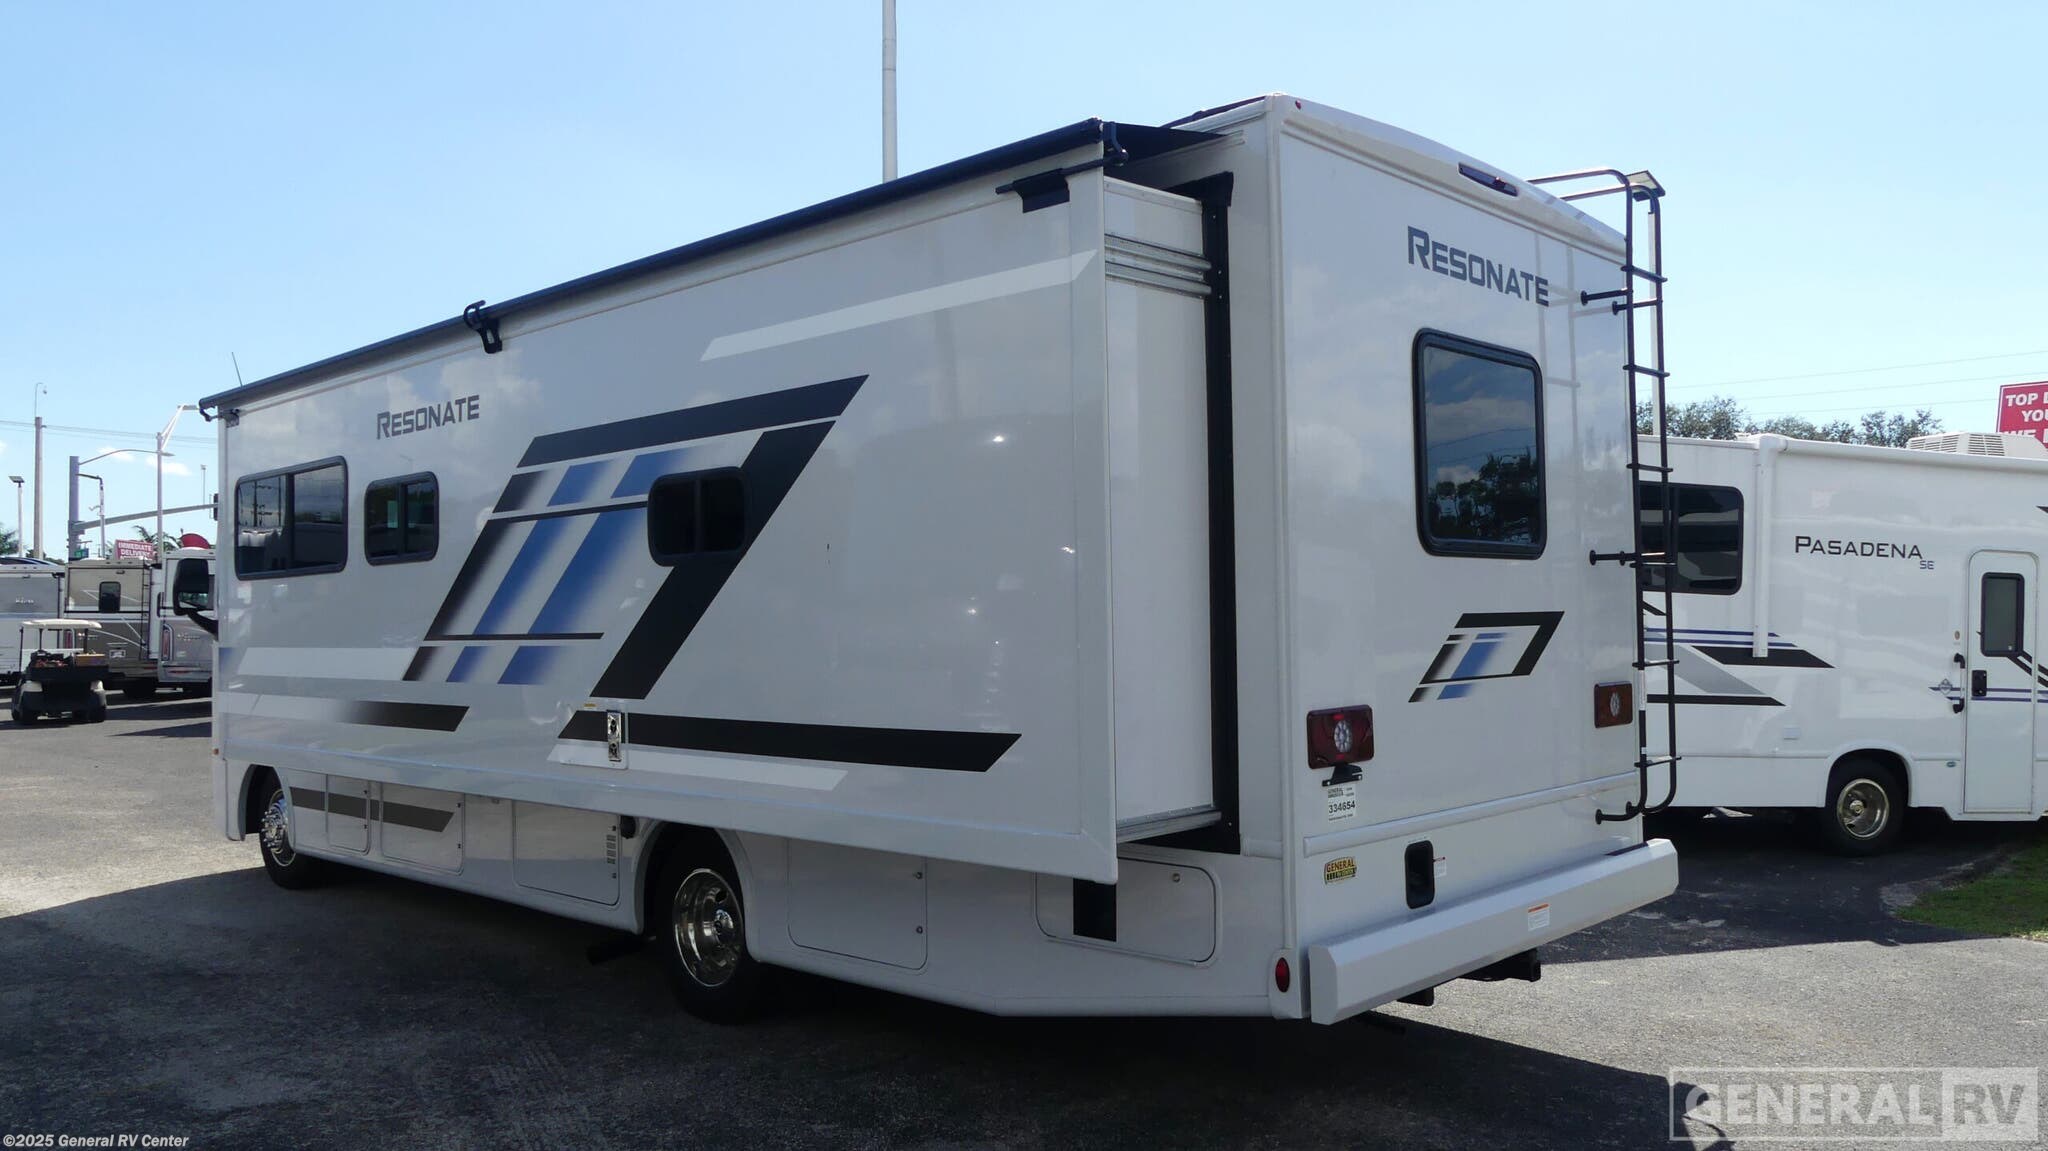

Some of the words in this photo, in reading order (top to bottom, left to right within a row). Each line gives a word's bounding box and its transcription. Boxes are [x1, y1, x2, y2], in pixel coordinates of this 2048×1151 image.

[1407, 225, 1550, 307] RESONATE
[2005, 392, 2039, 407] TOP
[377, 394, 480, 441] RESONATE
[118, 541, 152, 551] IMMEDIATE
[1795, 535, 1923, 560] PASADENA
[1919, 560, 1935, 570] SE
[1326, 859, 1354, 873] GENERAL
